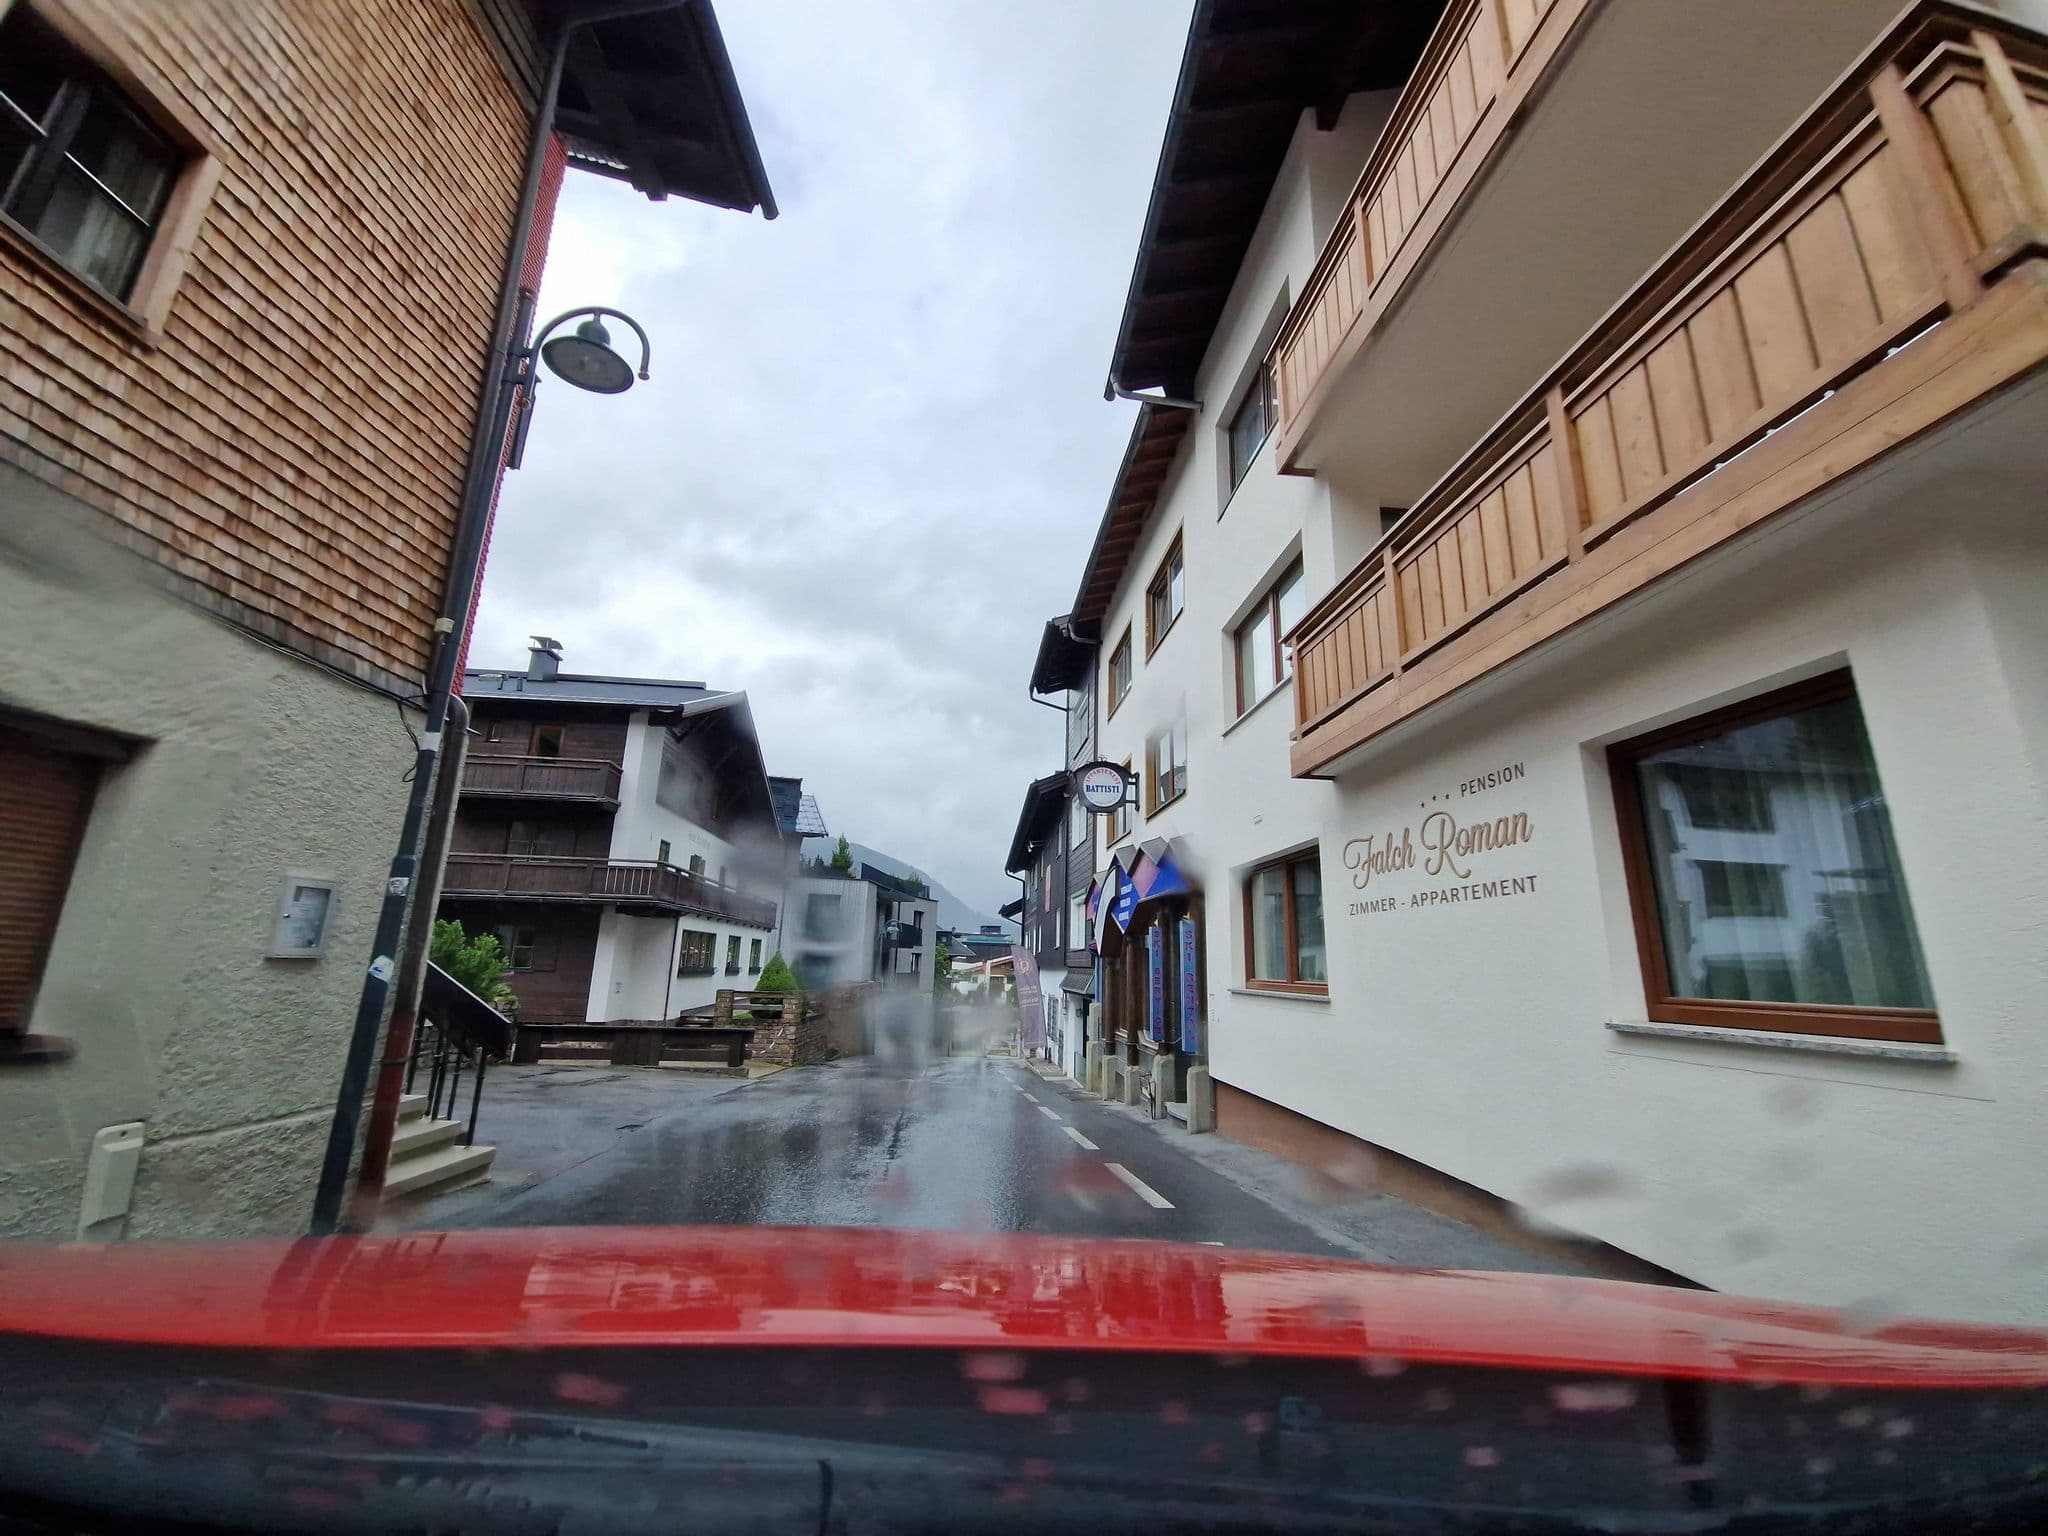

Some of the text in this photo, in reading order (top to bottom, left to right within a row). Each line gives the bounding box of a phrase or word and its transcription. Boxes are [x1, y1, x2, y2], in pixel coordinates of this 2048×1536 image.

[1085, 784, 1120, 793] BATTISTI
[1460, 762, 1525, 798] PENSION
[1343, 810, 1535, 890] Falch Roman
[1349, 897, 1397, 916] ZIMMER
[1410, 875, 1538, 909] APPARTEMENT
[1184, 930, 1194, 962] SKI
